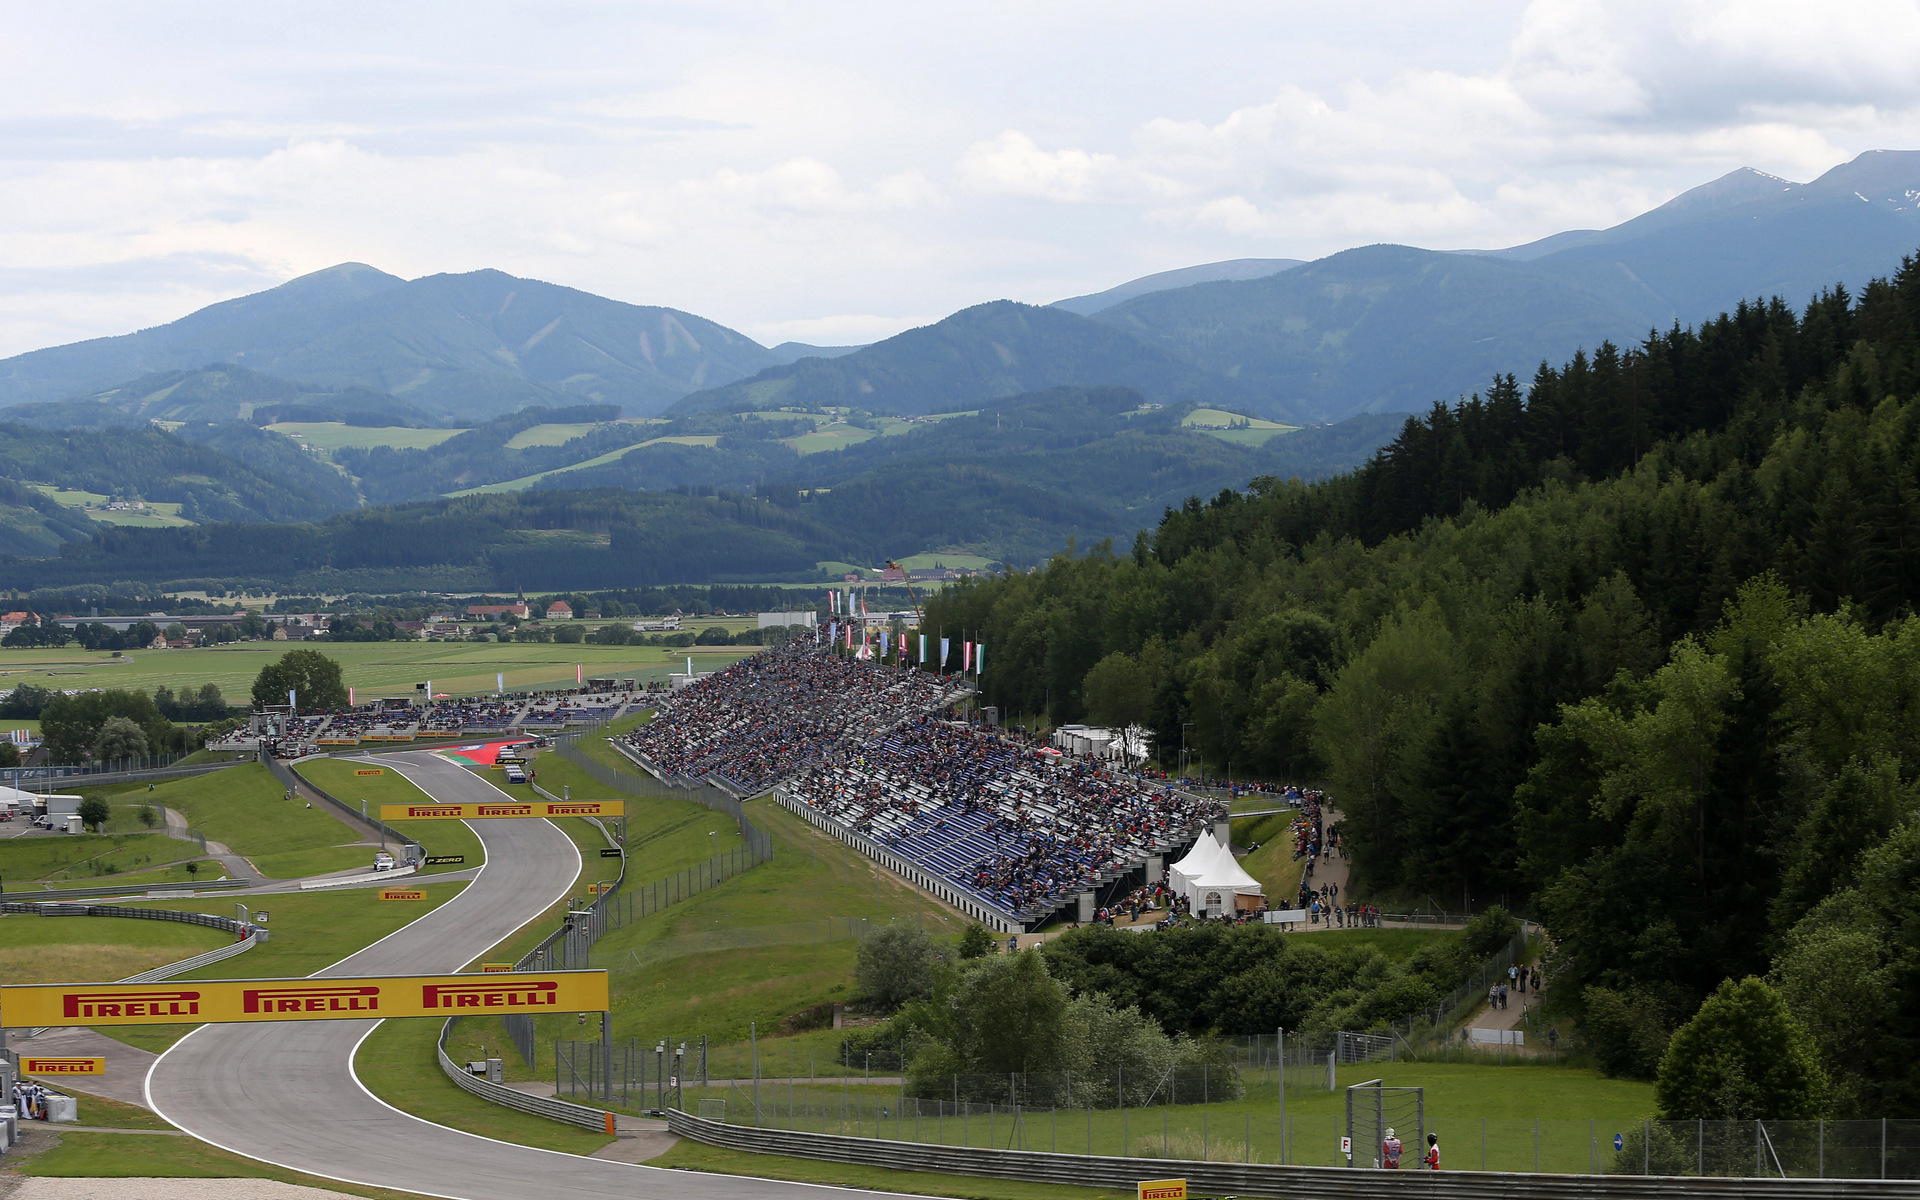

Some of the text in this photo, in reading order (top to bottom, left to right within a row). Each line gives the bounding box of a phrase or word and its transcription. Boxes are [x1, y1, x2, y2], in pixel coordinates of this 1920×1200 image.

[408, 804, 600, 816] PIRELLI PIRELLI PIRELLI
[63, 982, 558, 1018] PIRELLI PIRELLI PIRELLI
[29, 1060, 94, 1072] PIRELLI
[1343, 1140, 1348, 1149] F
[1142, 1187, 1183, 1199] PIRELLI
